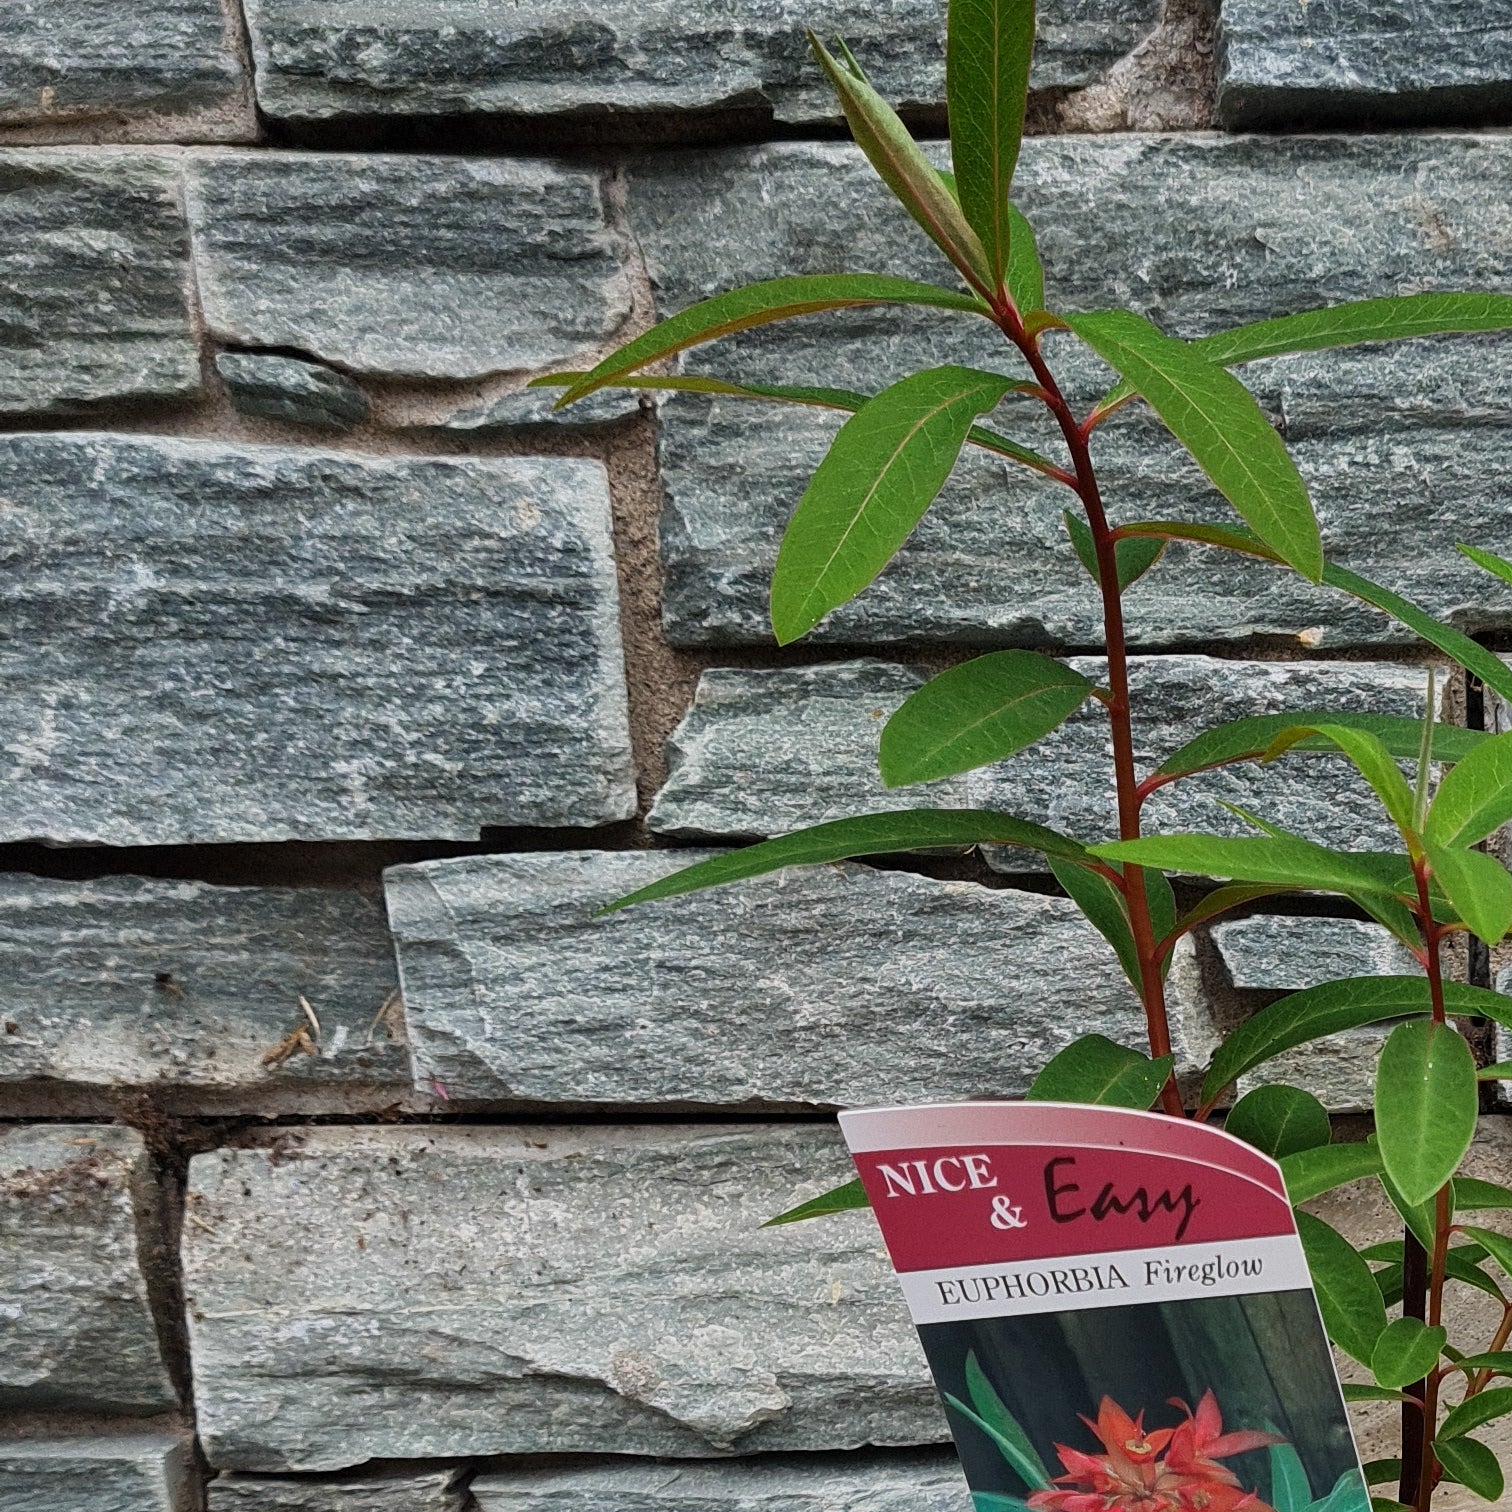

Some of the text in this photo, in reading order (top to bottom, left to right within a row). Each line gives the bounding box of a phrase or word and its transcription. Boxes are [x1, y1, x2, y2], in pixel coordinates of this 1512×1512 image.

[875, 1153, 1201, 1242] NICE & Easy
[935, 1254, 1264, 1306] EUPHORBIA Fireglow
